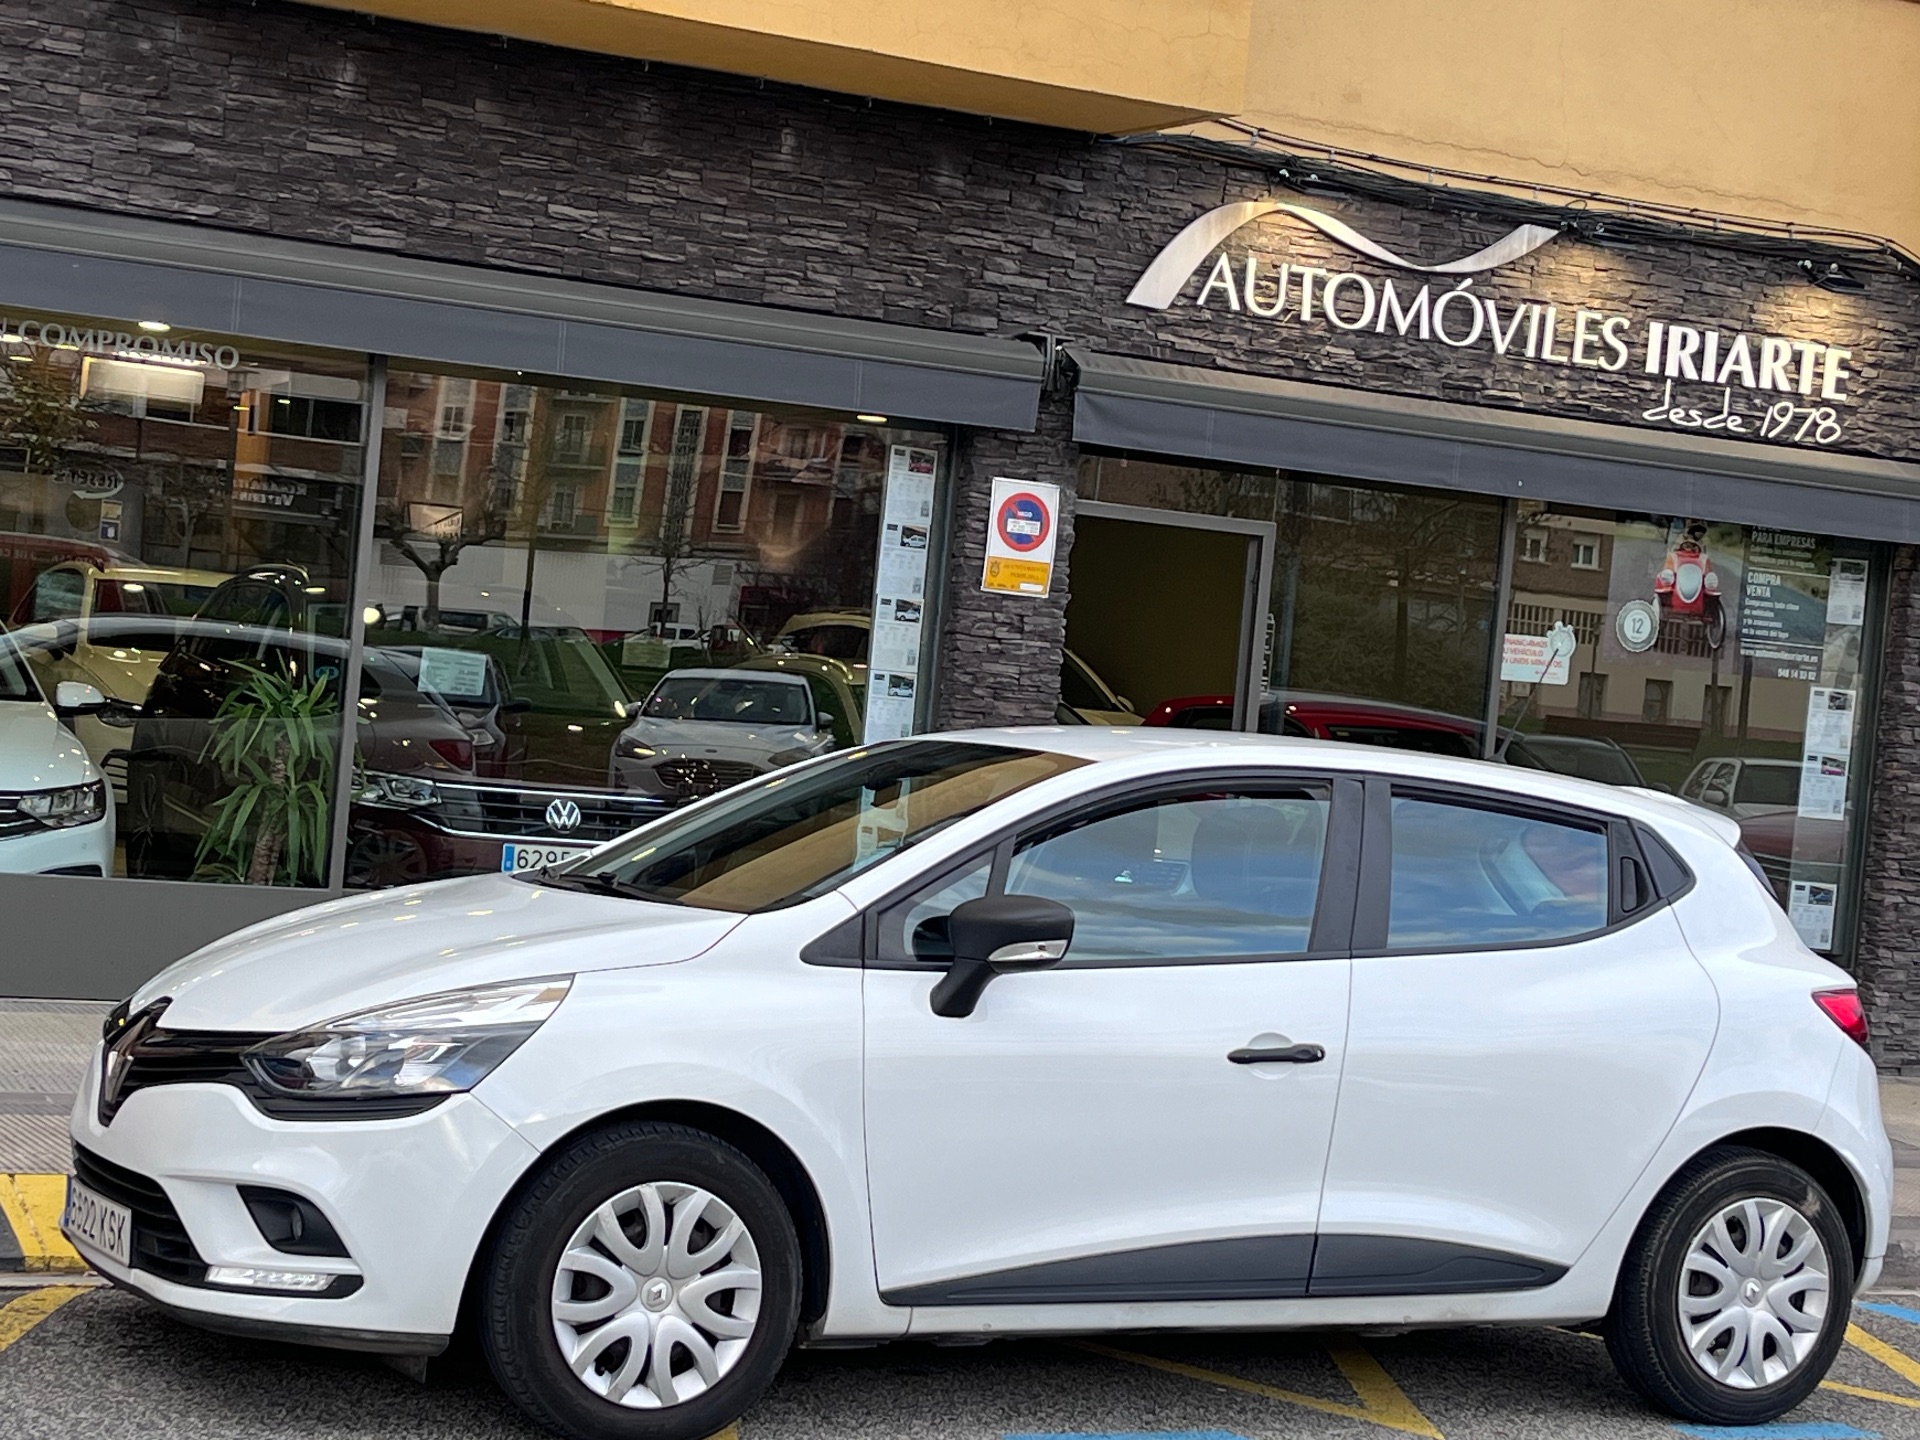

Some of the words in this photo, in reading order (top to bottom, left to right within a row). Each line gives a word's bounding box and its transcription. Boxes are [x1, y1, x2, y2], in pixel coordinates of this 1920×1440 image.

[1197, 251, 1630, 371] AUTOMÓVILES
[1645, 320, 1852, 402] IRIARTE
[18, 320, 241, 370] COMPROMISO
[1643, 378, 1746, 433] desde
[1759, 401, 1843, 444] 1978
[1751, 531, 1773, 545] PARA
[1774, 533, 1816, 549] EMPRESAS
[1746, 584, 1771, 598] VENTA
[1747, 571, 1781, 586] COMPRA
[1631, 617, 1644, 634] 12
[99, 1204, 126, 1257] KSK
